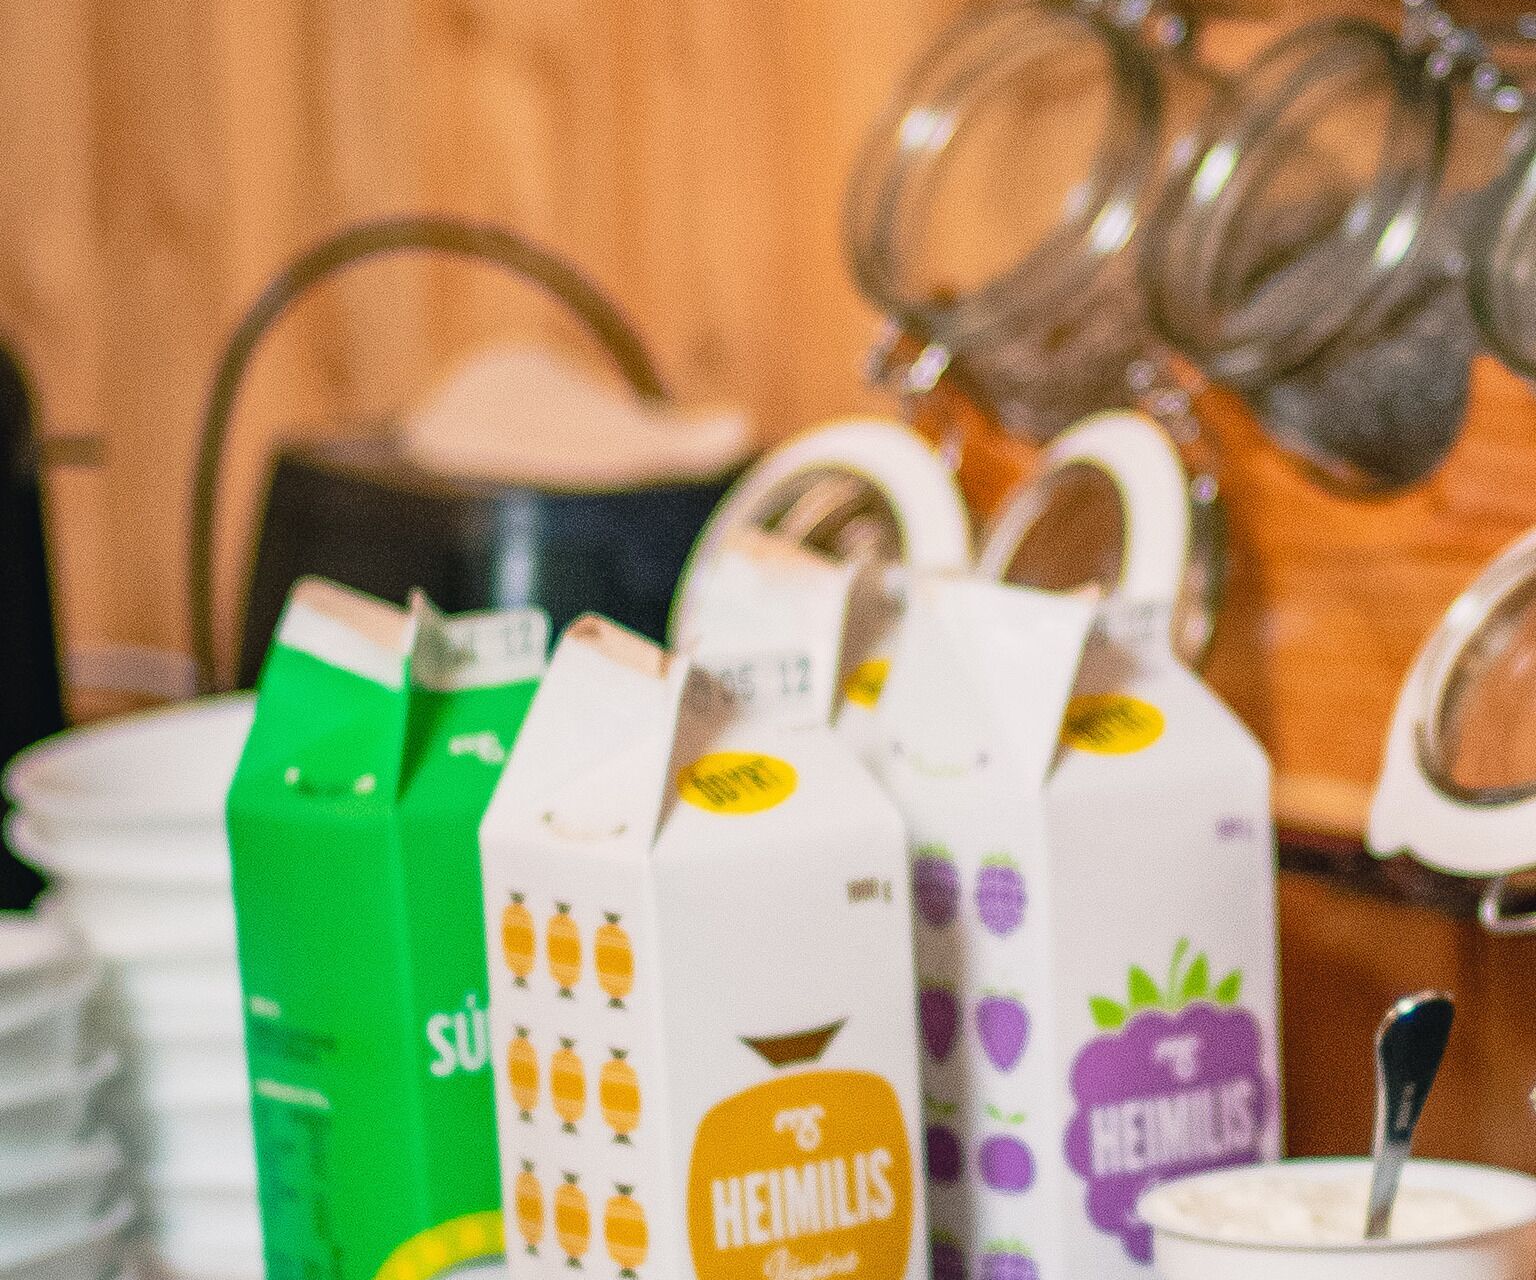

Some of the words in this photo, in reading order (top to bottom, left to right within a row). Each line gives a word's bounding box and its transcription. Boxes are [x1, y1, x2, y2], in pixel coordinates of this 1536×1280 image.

[426, 992, 491, 1077] SÚ
[1090, 1077, 1256, 1177] HEIMILIS
[711, 1148, 896, 1251] HEIMILIS
